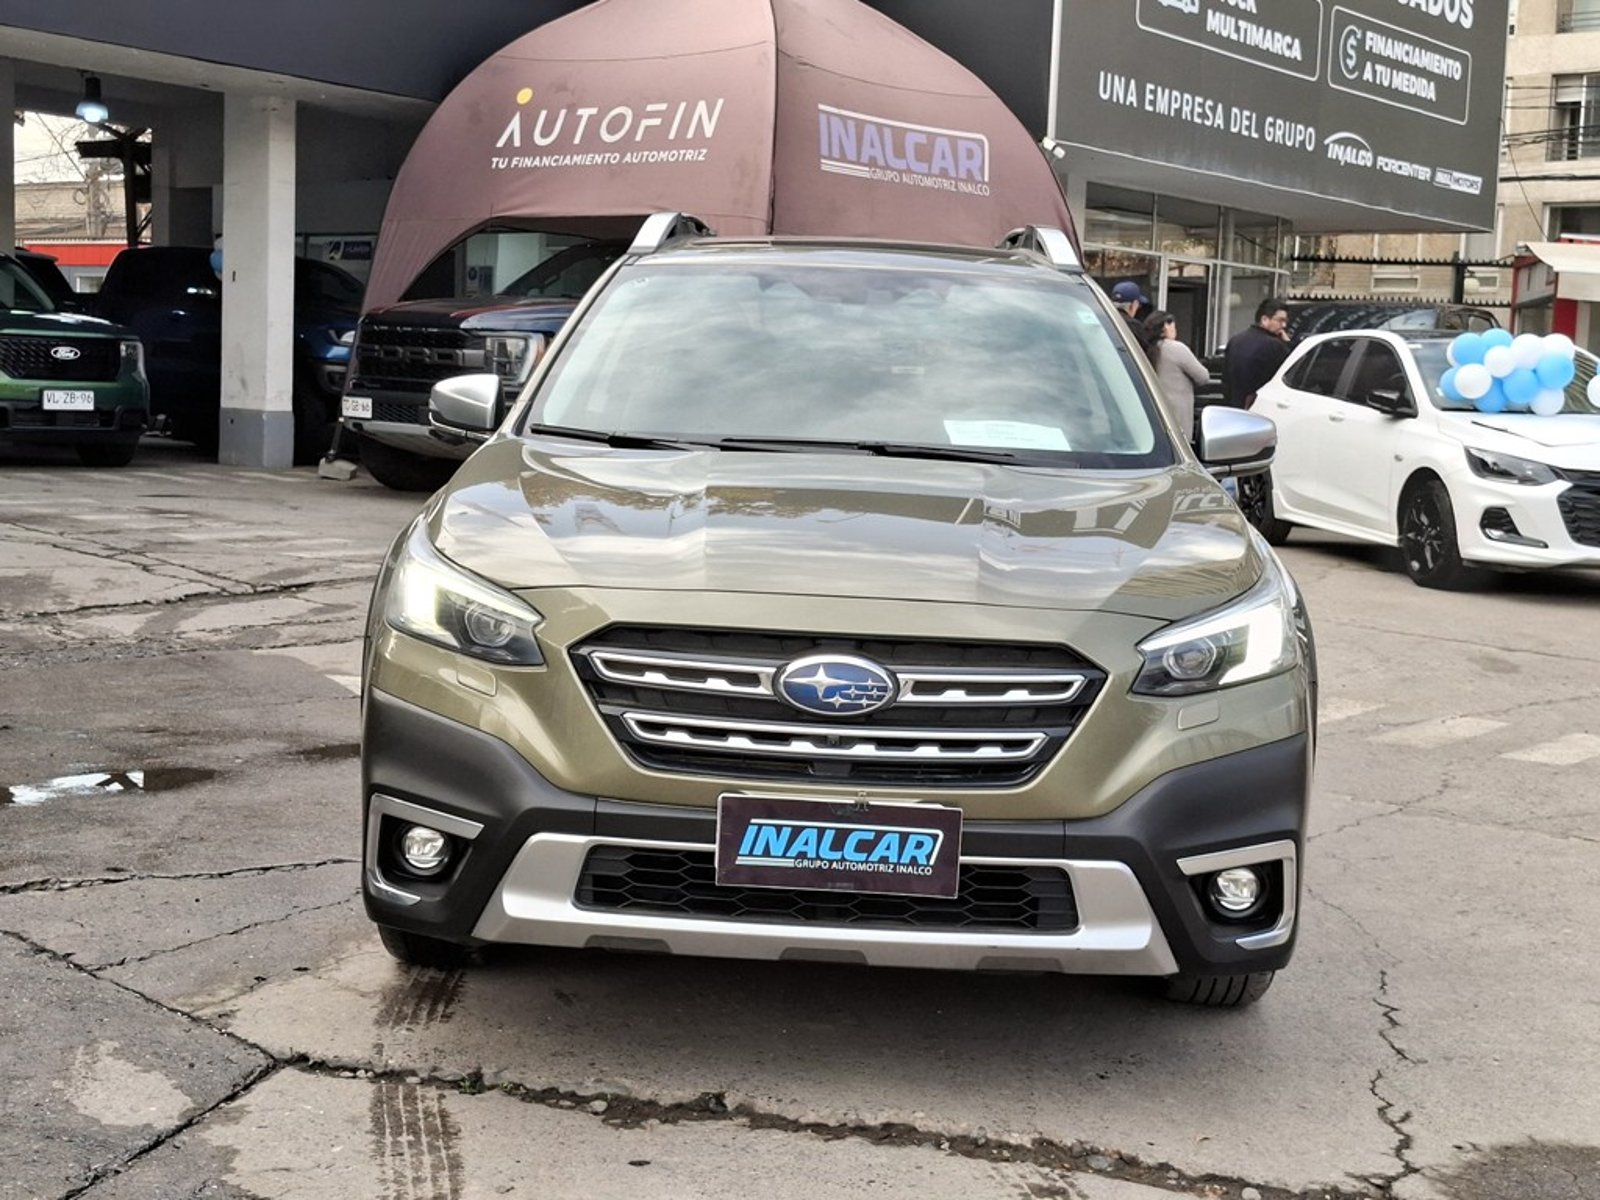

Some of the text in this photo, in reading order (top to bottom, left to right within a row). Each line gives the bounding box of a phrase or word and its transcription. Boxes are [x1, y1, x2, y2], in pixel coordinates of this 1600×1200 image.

[1206, 9, 1302, 61] MULTIMARCA
[1365, 31, 1462, 81] FINANCIAMIENTO
[1362, 61, 1436, 102] A TU MEDIDA
[496, 98, 724, 148] AUTOFIN
[1098, 71, 1137, 108] UNA
[1144, 83, 1225, 130] EMPRESA
[1230, 106, 1260, 139] DEL
[1264, 116, 1316, 152] GRUPO
[1376, 155, 1432, 182] FORCENTER
[491, 149, 708, 169] TU FINANCIAMIENTO AUTOMOTRIZ
[818, 113, 984, 182] INALCAR
[869, 168, 990, 197] GRUPO AUTOMOTRIZ INALCO
[738, 824, 934, 865] INALCAR
[795, 859, 933, 876] GRUPO AUTOMOTRIZ INALCO
